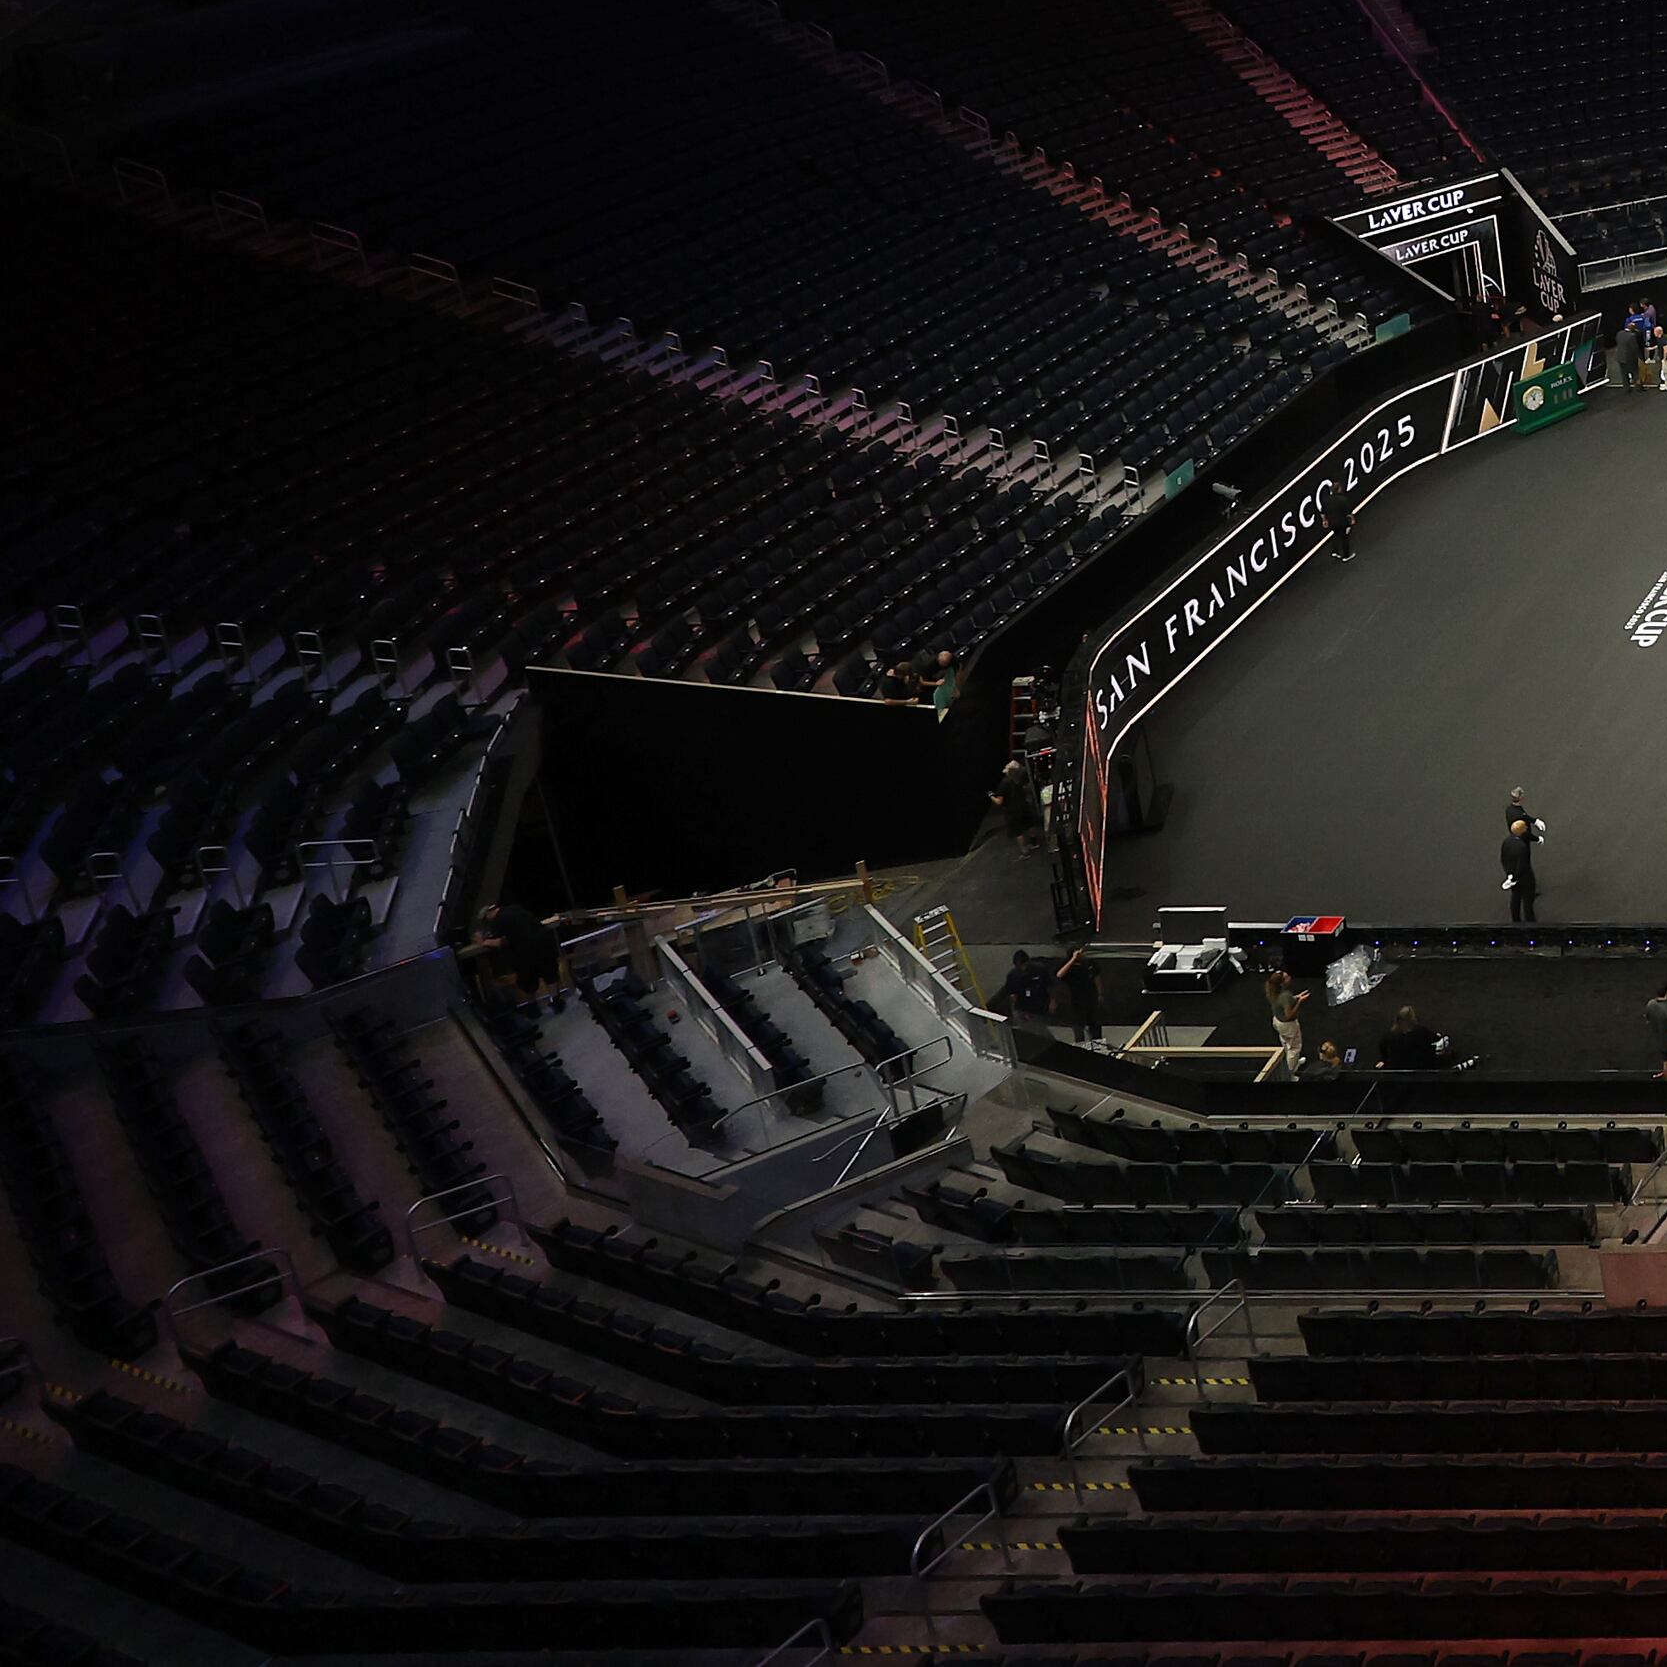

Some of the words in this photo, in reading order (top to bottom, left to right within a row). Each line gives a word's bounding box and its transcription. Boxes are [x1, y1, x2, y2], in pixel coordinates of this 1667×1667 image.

[1368, 201, 1426, 230] LAVER
[1427, 190, 1465, 211] CUP
[1395, 240, 1440, 261] LAVER
[1441, 229, 1469, 247] CUP
[1532, 268, 1567, 304] LAVER
[1540, 292, 1561, 314] CUP
[1551, 375, 1573, 389] ROLEX
[1095, 642, 1154, 730] SAN
[1343, 413, 1417, 492] 2025
